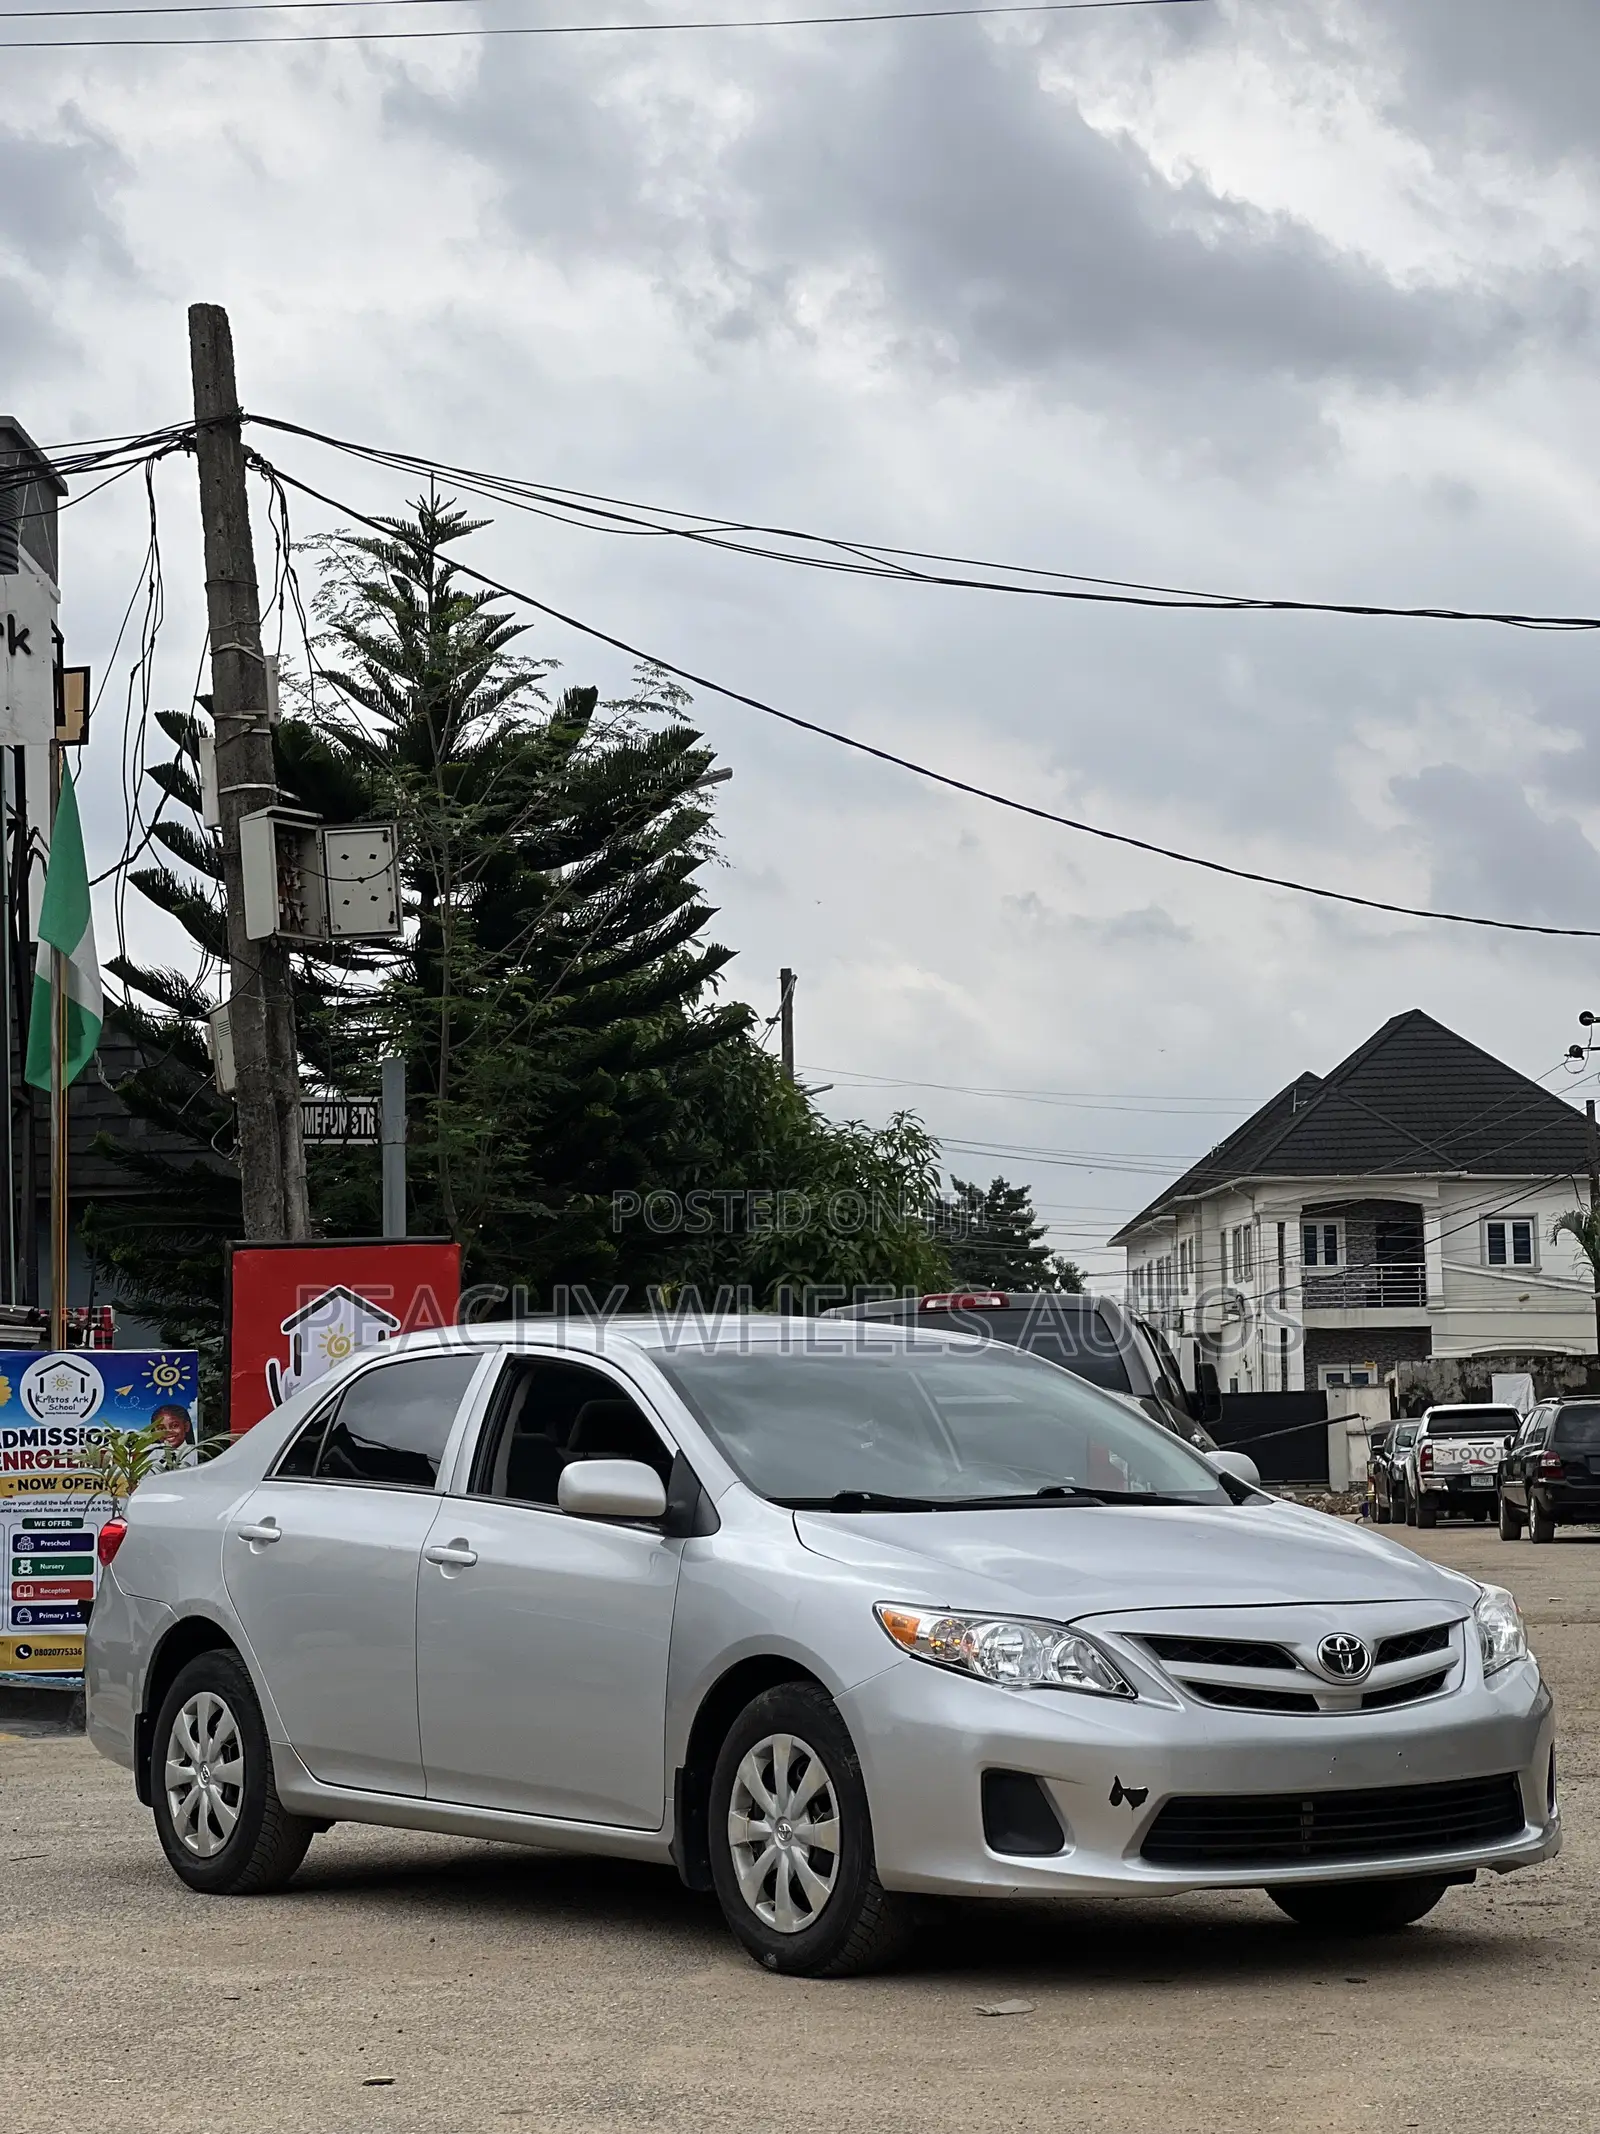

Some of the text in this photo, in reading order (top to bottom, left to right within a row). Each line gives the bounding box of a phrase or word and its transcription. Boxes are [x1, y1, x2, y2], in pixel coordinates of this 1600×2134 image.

[72, 1395, 89, 1403] Ark
[0, 1427, 120, 1448] DMISSIO
[1448, 1447, 1507, 1461] TOYOT
[18, 1477, 109, 1491] NOW OPEN!
[40, 1563, 65, 1571] Nursery
[40, 1586, 71, 1595] Reception
[39, 1612, 64, 1620] Primary
